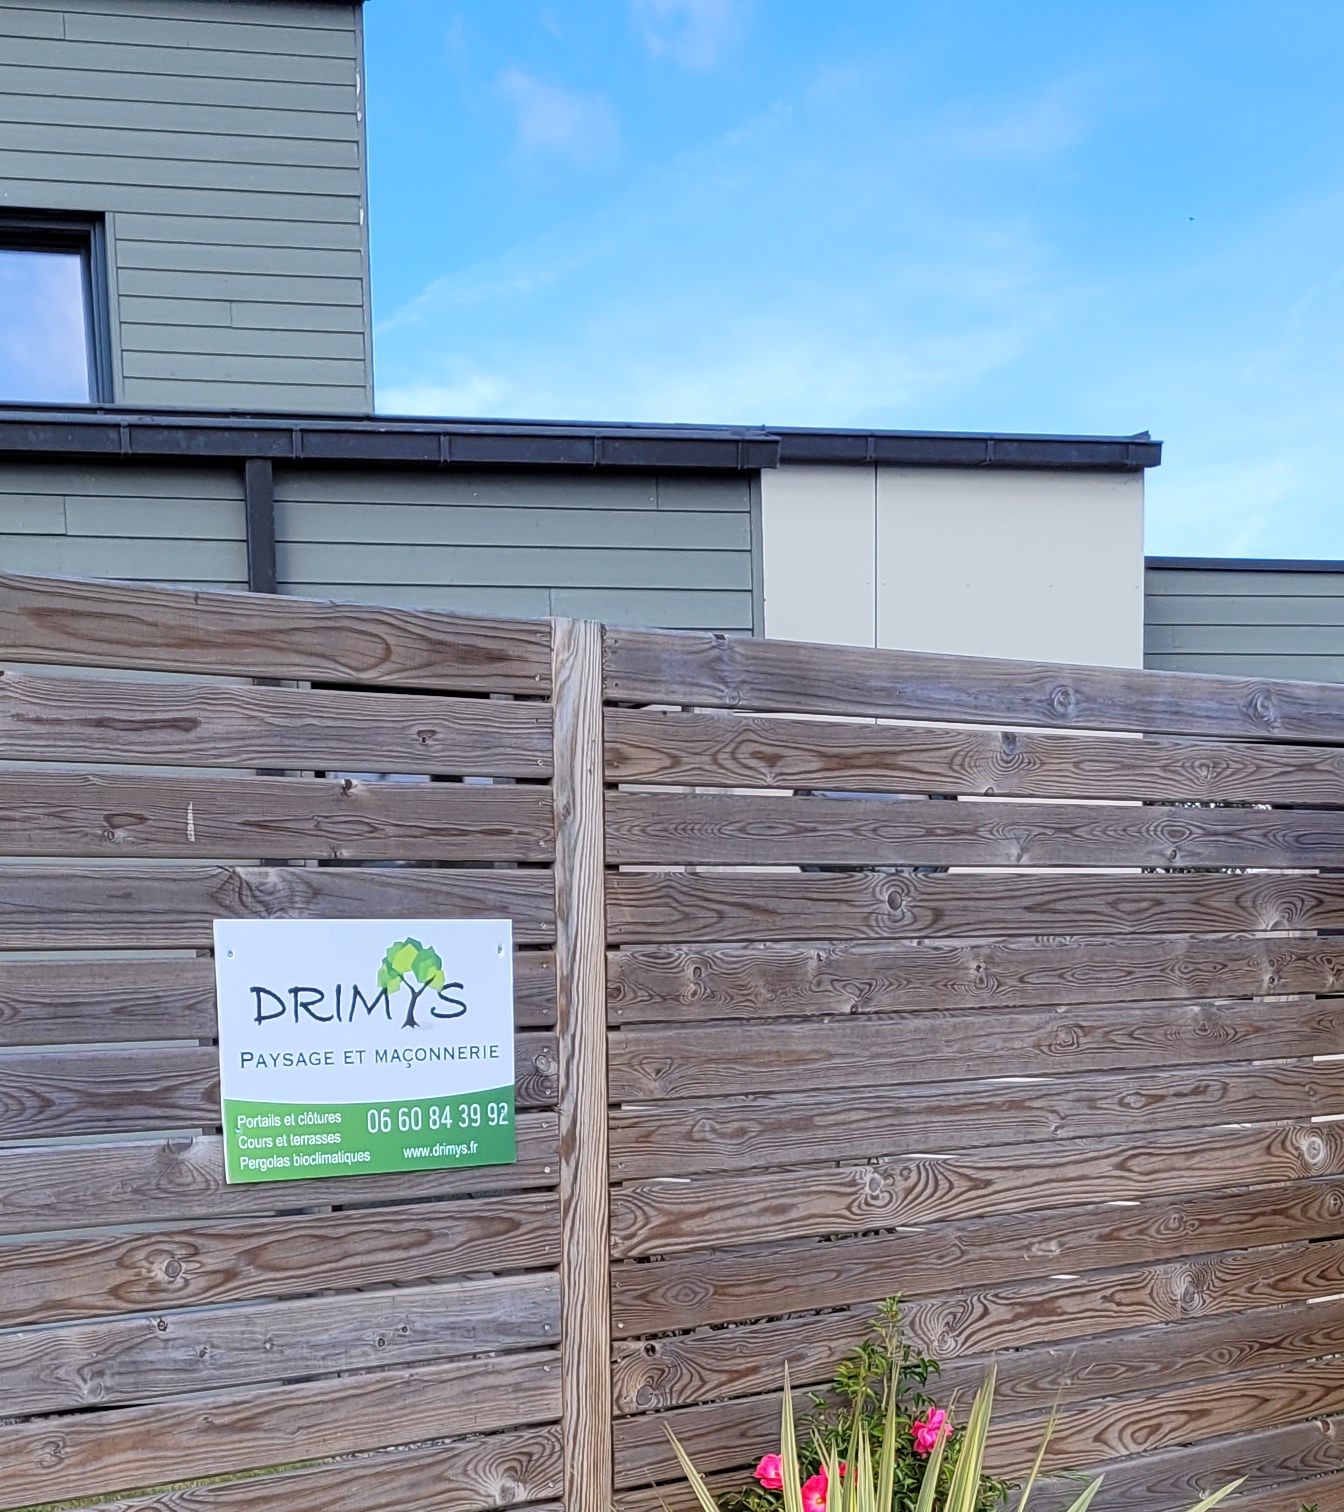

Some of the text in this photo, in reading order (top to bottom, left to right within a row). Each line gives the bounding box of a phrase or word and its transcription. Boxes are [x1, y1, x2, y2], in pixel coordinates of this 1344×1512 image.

[250, 974, 467, 1029] DRIMYS
[240, 1044, 500, 1069] PAYSAGE ET MAÇONNERIE
[237, 1111, 342, 1128] Portails et clôtures
[367, 1102, 509, 1133] 06 60 84 39 92
[238, 1132, 342, 1149] Cours et terrasses
[402, 1140, 479, 1159] www.drimys.fr
[239, 1150, 371, 1172] Pergolas bioclimatiques
